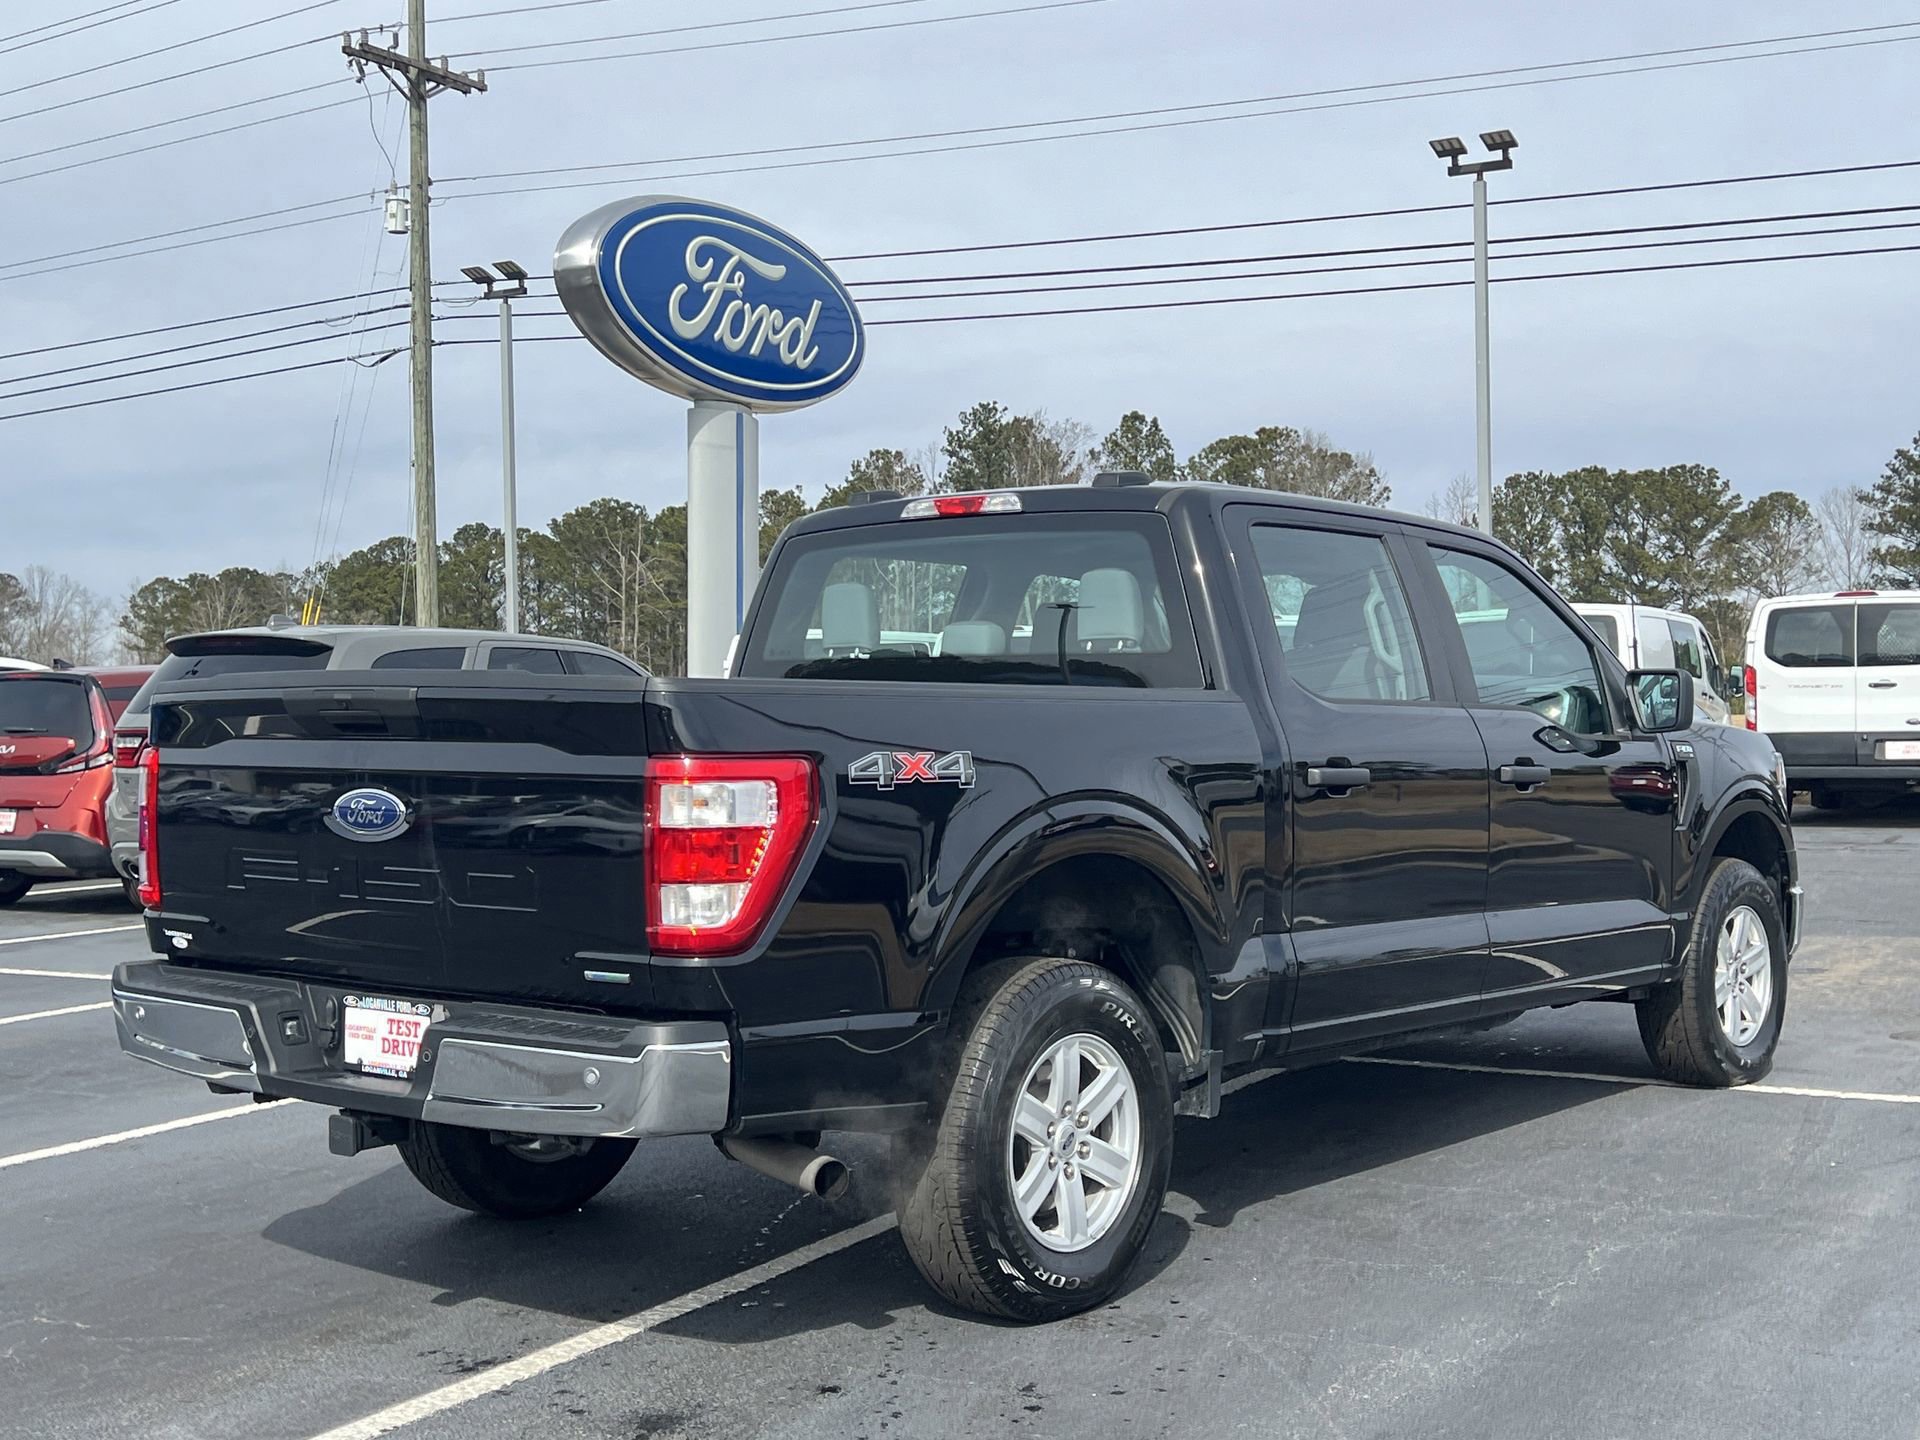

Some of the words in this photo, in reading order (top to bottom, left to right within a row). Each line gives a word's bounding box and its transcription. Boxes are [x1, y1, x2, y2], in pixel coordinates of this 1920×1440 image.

[668, 235, 822, 369] Ford
[347, 797, 386, 825] Ford
[387, 1019, 420, 1038] TEST
